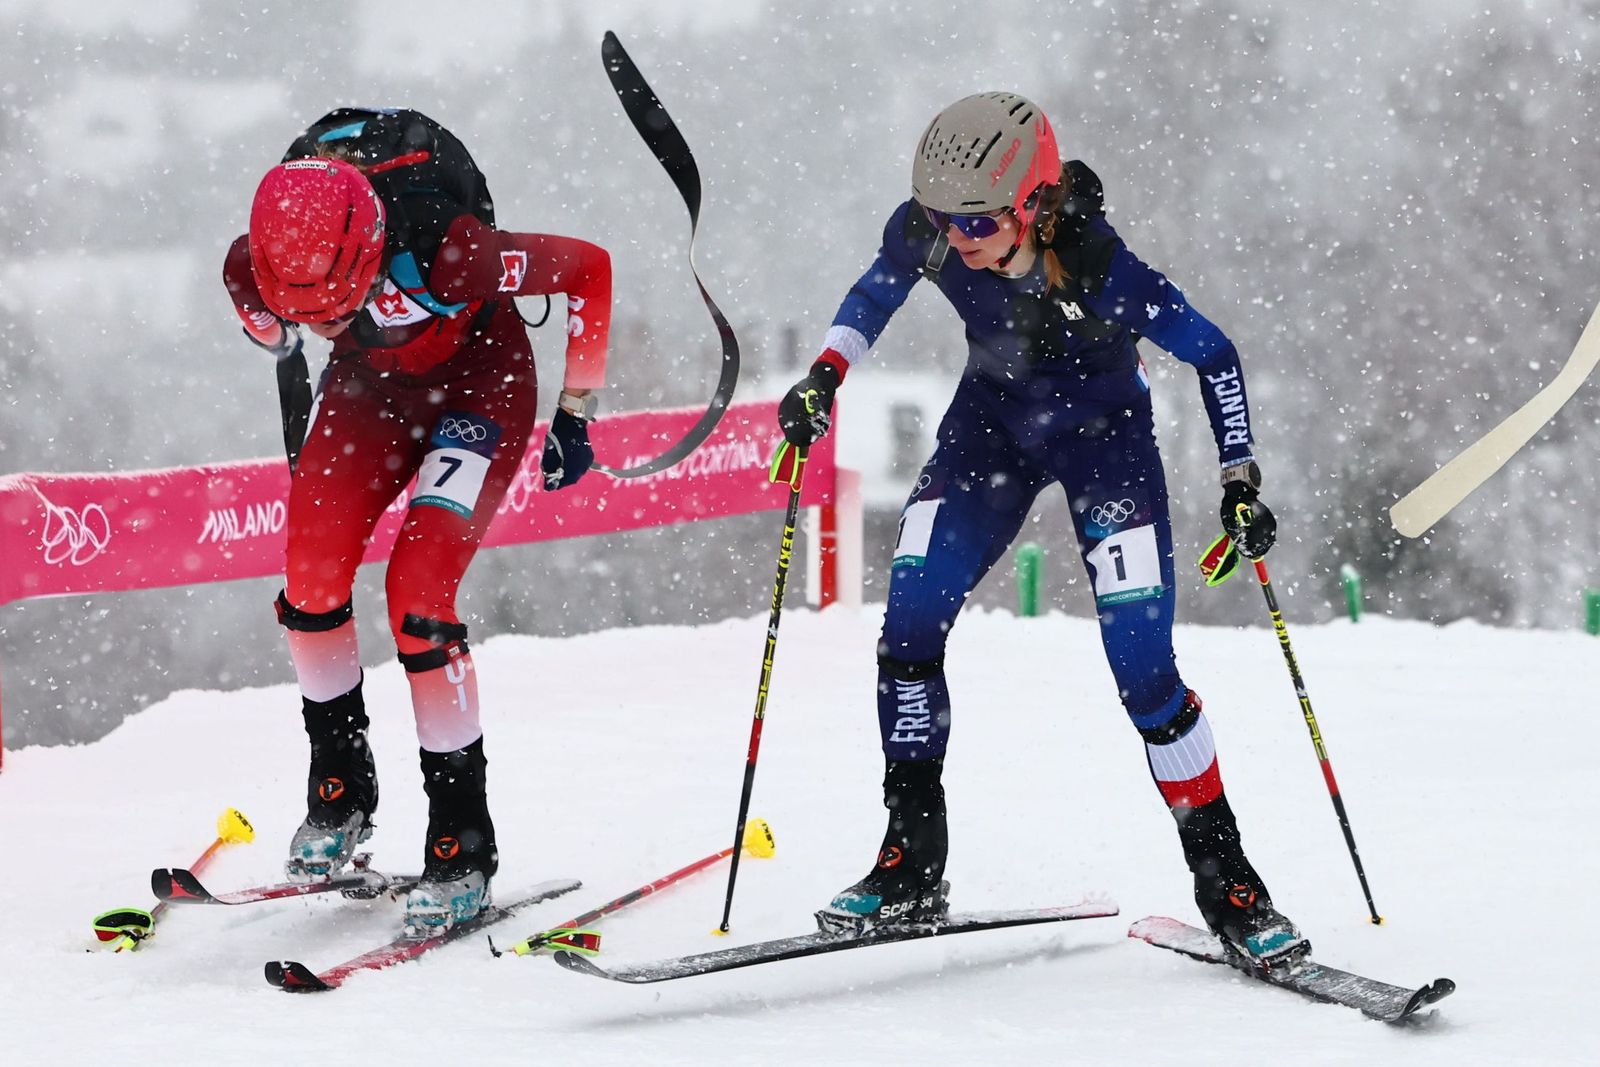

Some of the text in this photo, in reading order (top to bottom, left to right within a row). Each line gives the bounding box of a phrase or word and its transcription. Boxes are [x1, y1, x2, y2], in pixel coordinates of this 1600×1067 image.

[1205, 366, 1249, 452] RANCE
[433, 455, 463, 488] 7
[197, 499, 287, 545] MILANO
[779, 524, 796, 569] LEKI
[1108, 544, 1127, 582] 1
[1269, 610, 1291, 644] LEKI
[889, 678, 931, 744] FRAN
